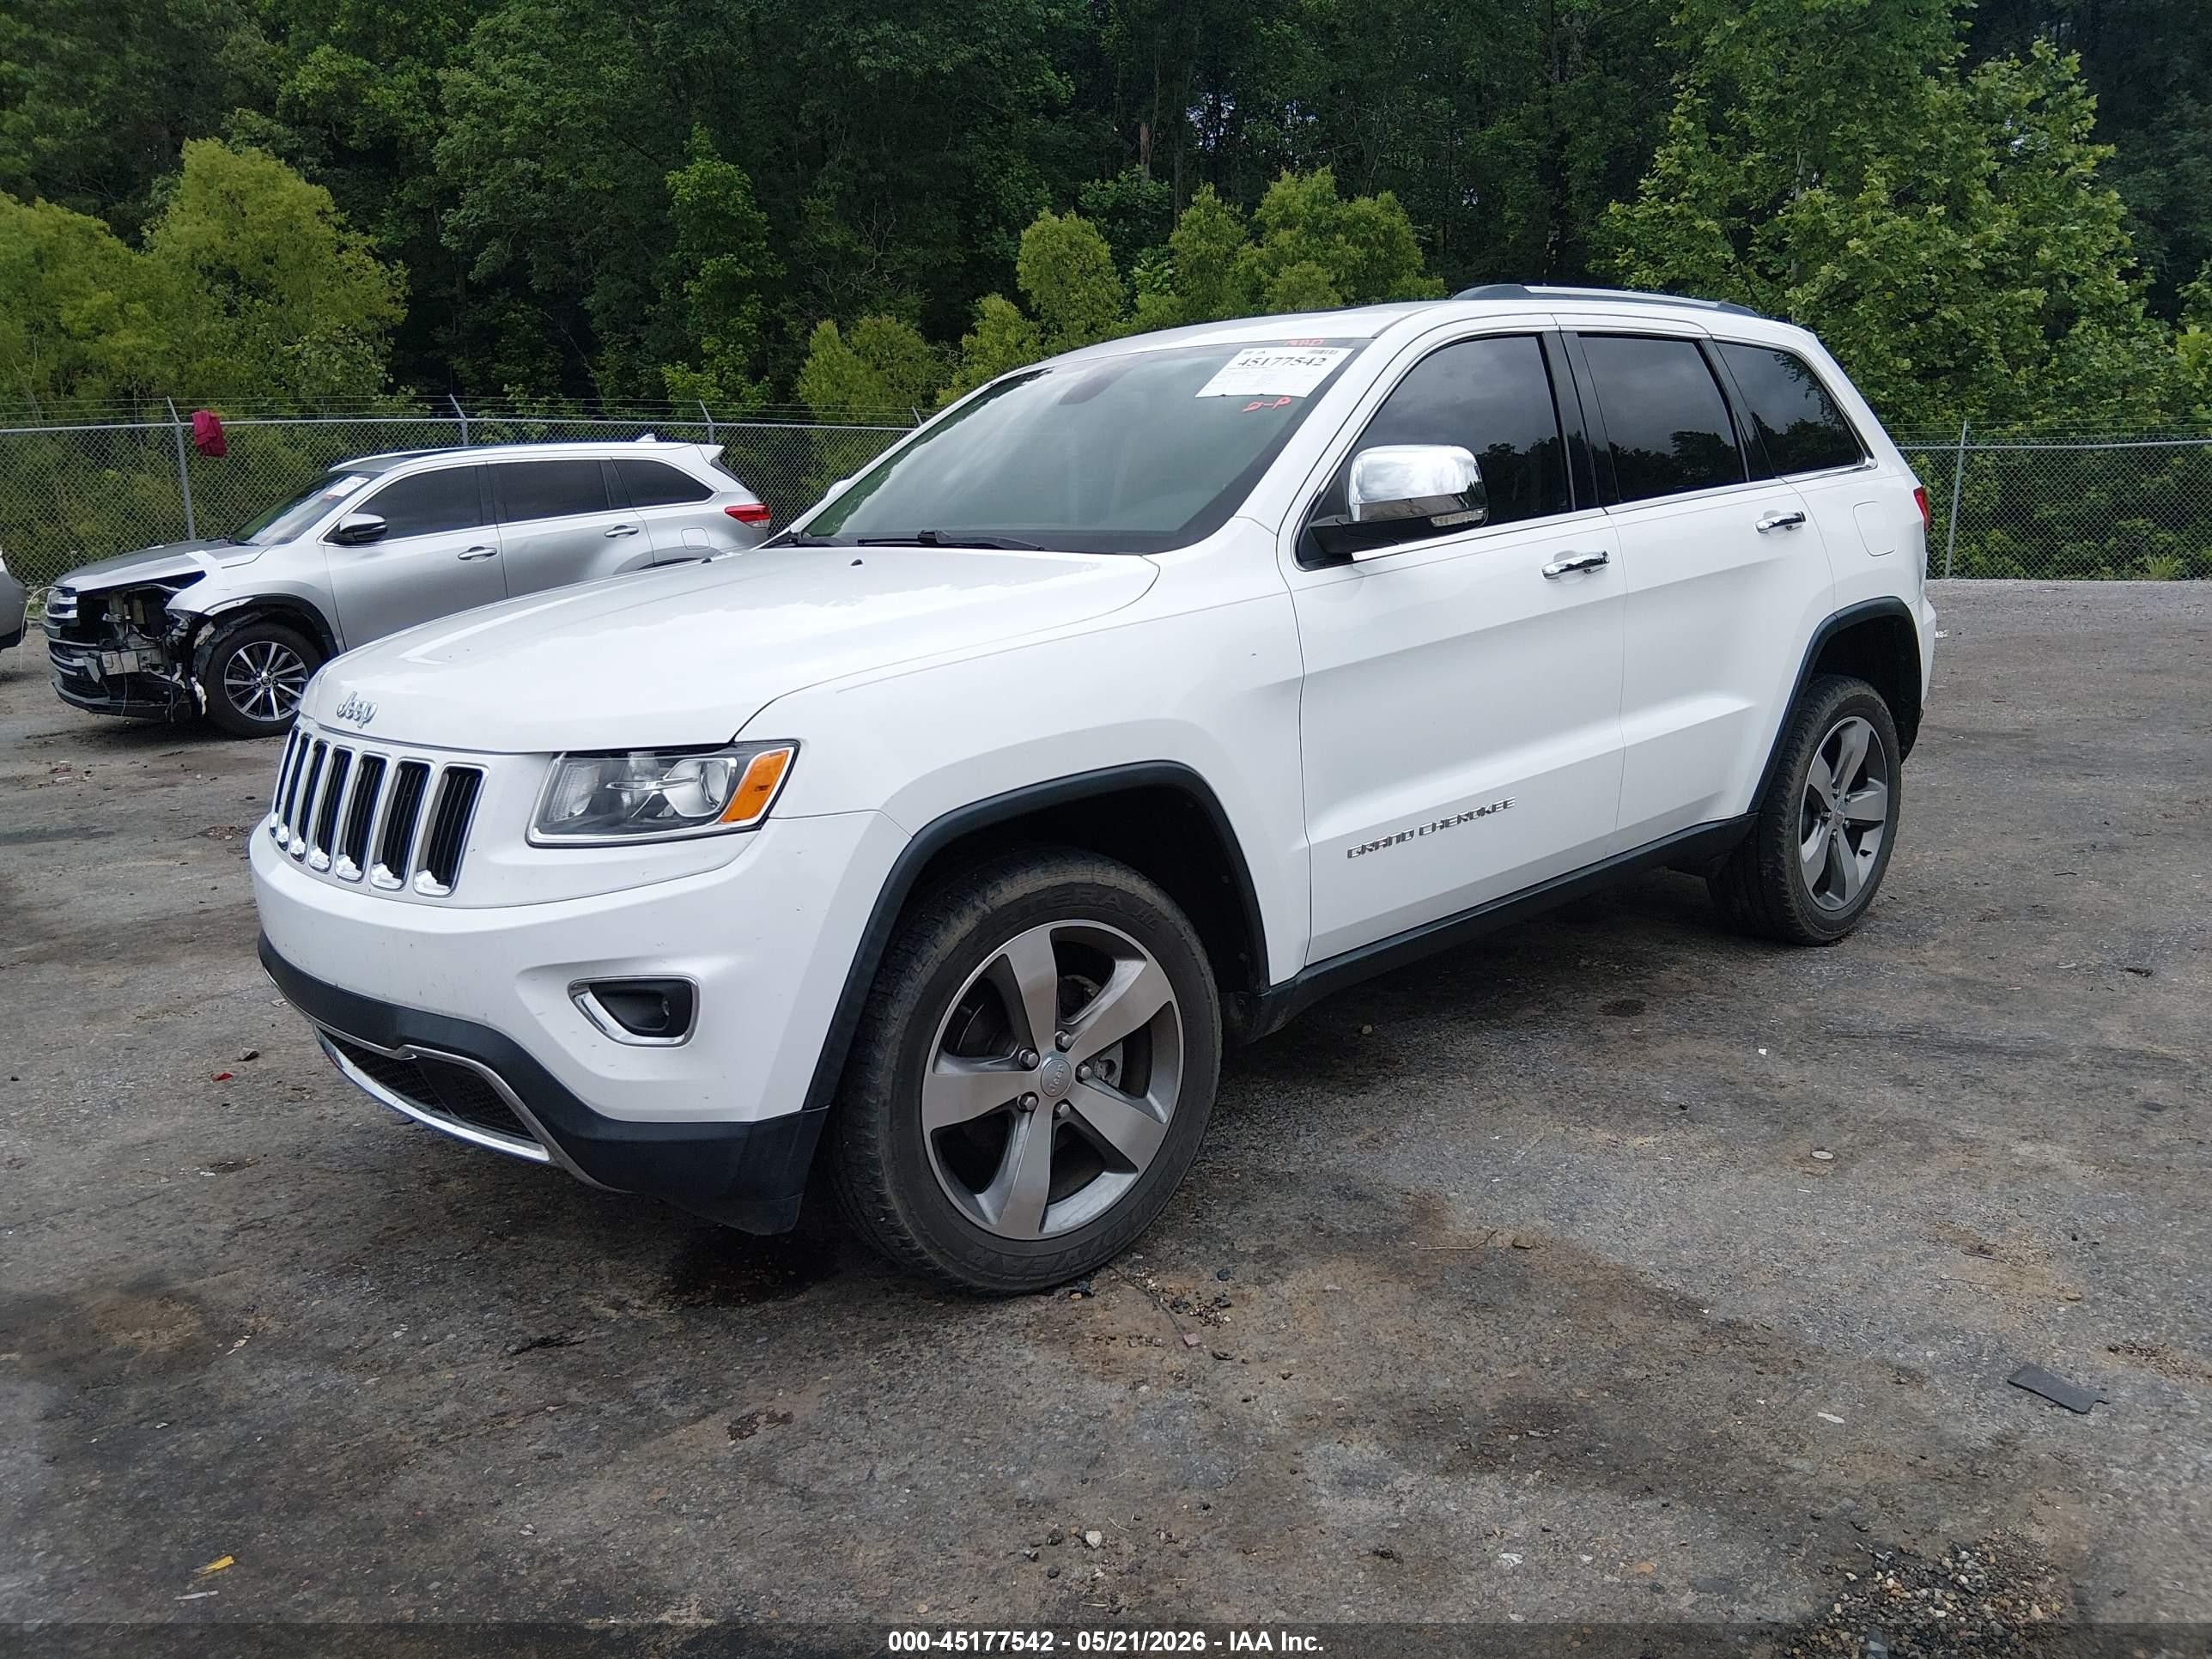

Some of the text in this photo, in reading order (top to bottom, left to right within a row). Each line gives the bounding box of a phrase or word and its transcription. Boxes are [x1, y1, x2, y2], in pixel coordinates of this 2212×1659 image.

[1237, 357, 1328, 367] 45177542
[337, 691, 378, 729] Jeep
[1347, 796, 1516, 859] GRAND CHEROKEE
[1048, 1064, 1065, 1092] Jeep
